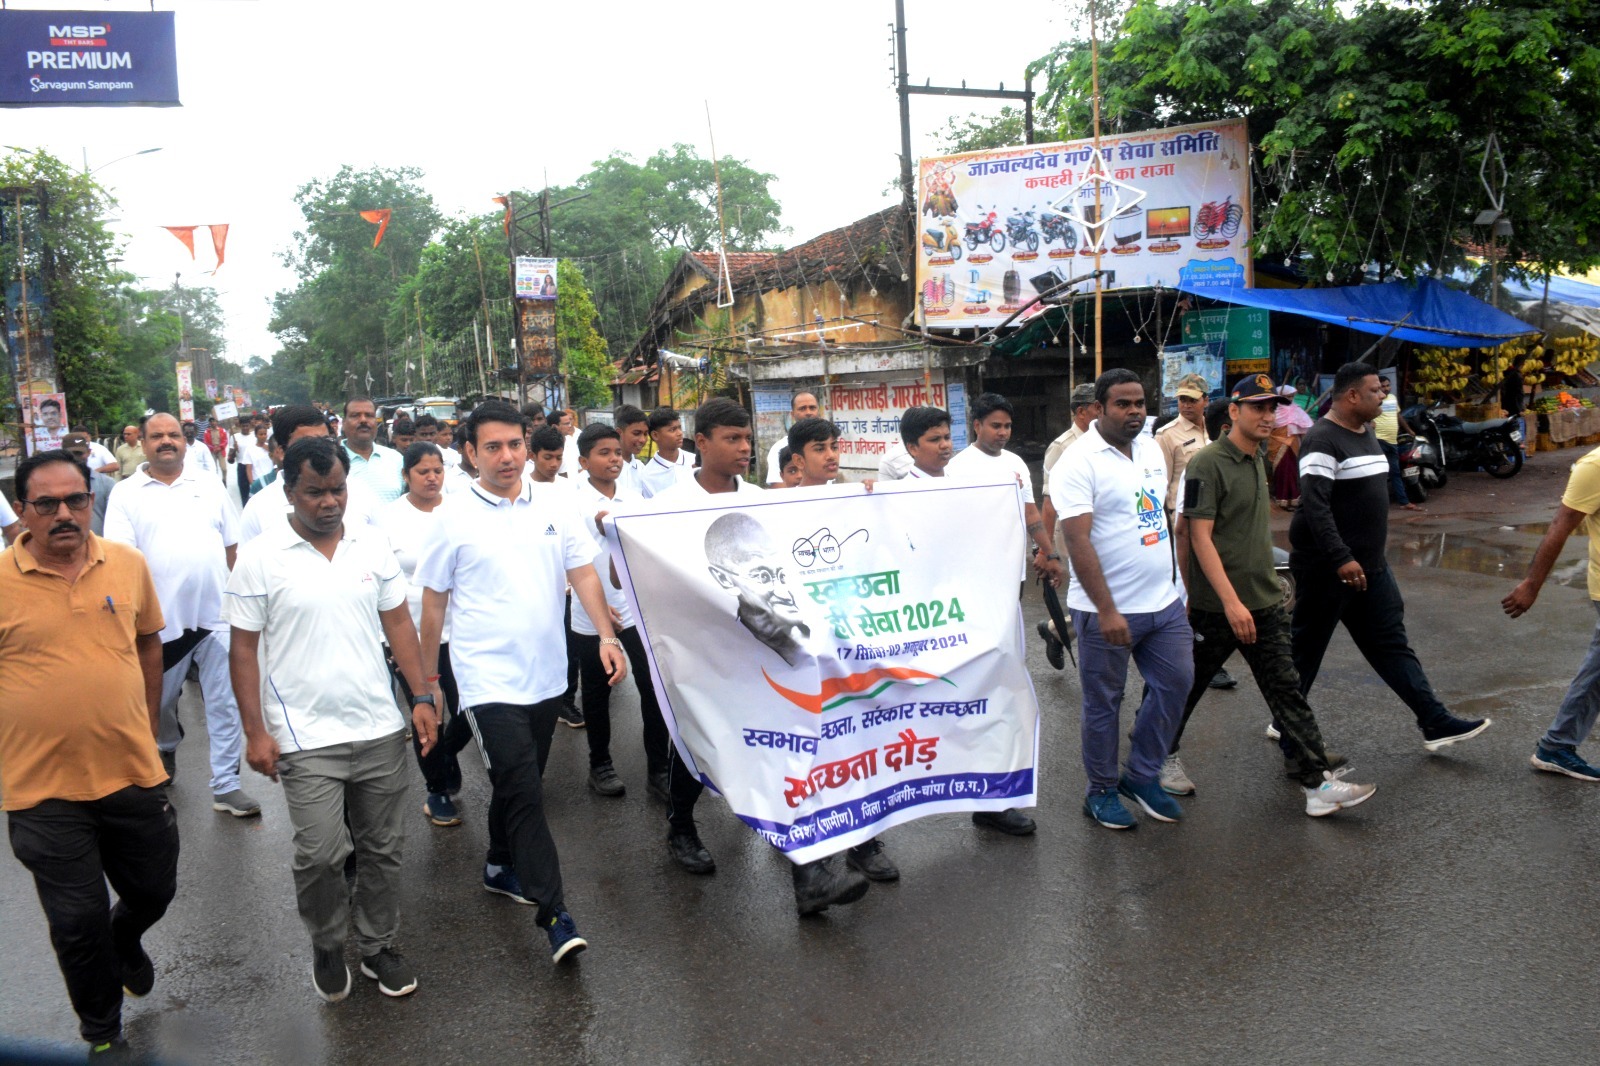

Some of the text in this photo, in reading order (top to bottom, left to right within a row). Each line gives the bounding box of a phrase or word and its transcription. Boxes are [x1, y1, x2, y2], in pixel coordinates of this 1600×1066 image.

[49, 25, 106, 38] MSP
[27, 51, 132, 69] PREMIUM
[30, 77, 133, 92] Sarvagunn Sampann
[967, 152, 1060, 176] जाज्वल्यदेव
[1119, 142, 1155, 160] सेवा
[1160, 131, 1220, 156] समिति
[1025, 168, 1073, 189] कचहरी
[1115, 167, 1136, 180] का
[1140, 163, 1175, 178] राजा
[1248, 313, 1262, 322] 113
[1252, 330, 1262, 339] 49
[891, 379, 944, 408] गारमेनस
[852, 417, 868, 434] रोड
[871, 415, 902, 434] जाँजगी
[854, 604, 902, 637] सेवा
[902, 597, 966, 631] 2024
[930, 633, 968, 650] 2024
[743, 728, 821, 755] स्वभाव
[861, 702, 917, 729] संस्कार
[919, 698, 989, 717] स्वच्छता
[884, 728, 940, 771] दौड़
[861, 800, 881, 827] जिला
[949, 778, 988, 797] (छ.ग.)
